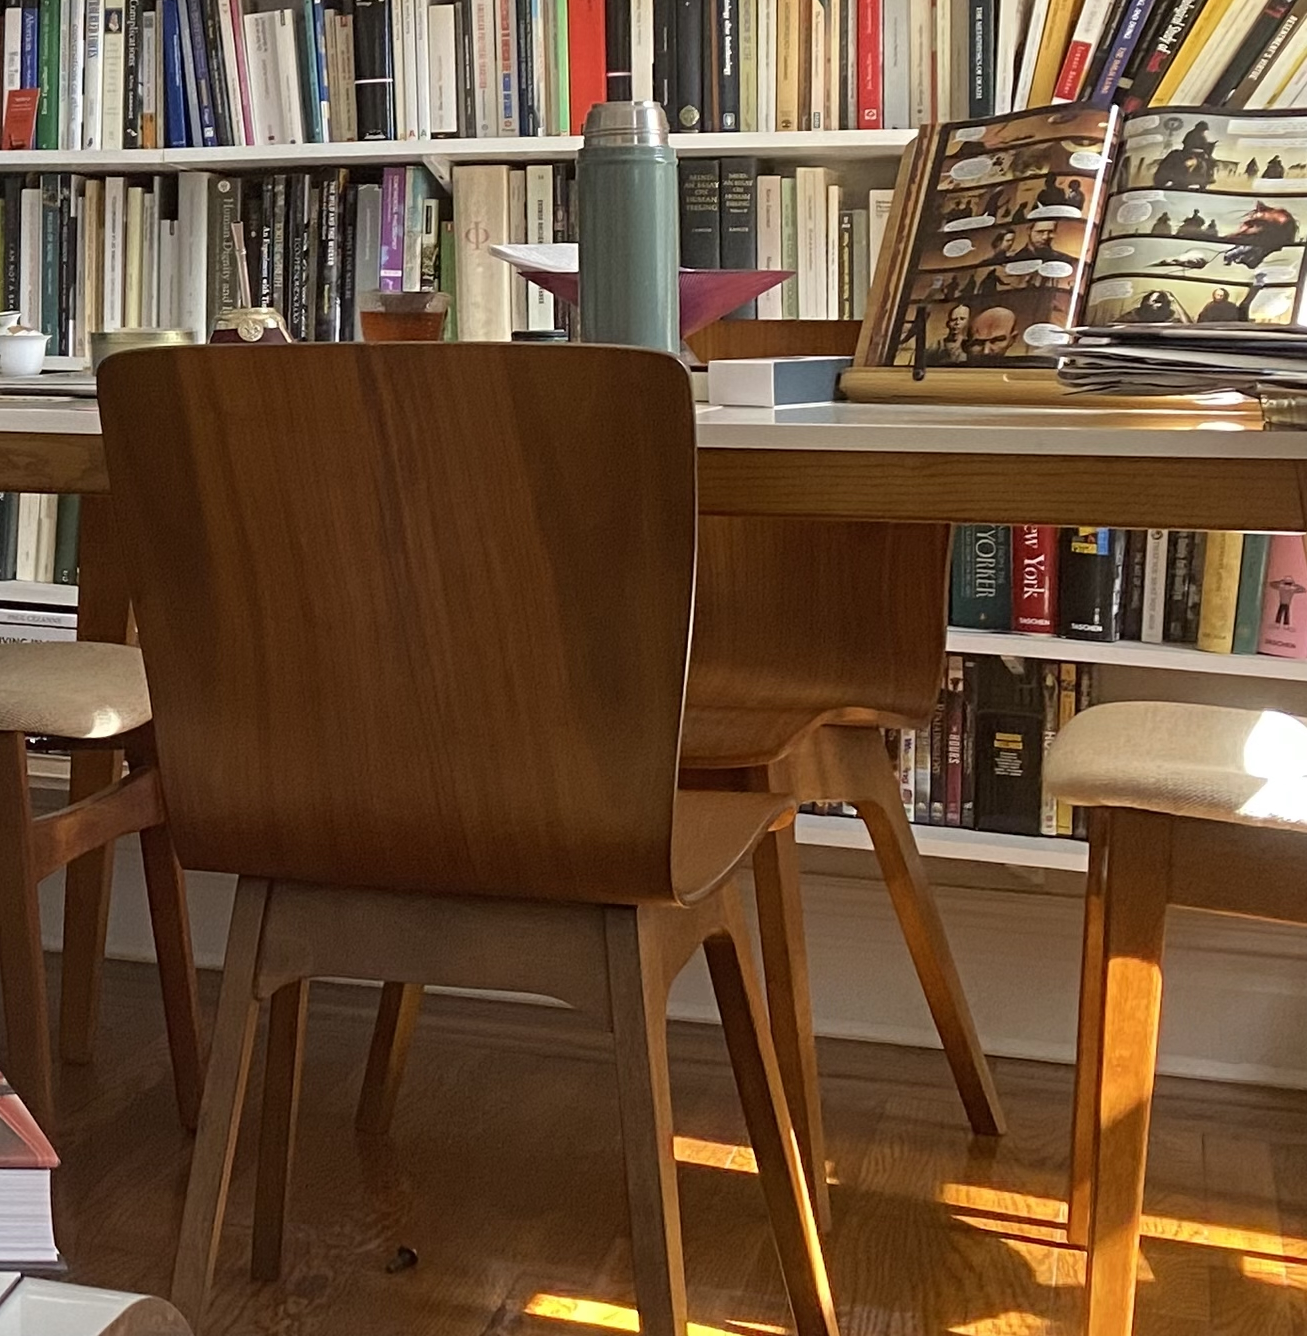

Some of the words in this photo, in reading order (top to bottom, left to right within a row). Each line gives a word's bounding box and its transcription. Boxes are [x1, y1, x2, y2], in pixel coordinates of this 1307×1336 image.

[25, 12, 34, 51] Abortion
[1159, 24, 1183, 45] Study
[1263, 15, 1297, 59] RESENTMENT'S
[1156, 44, 1171, 55] of
[975, 66, 982, 75] OF
[1248, 59, 1269, 80] VIRTUE
[223, 198, 233, 238] Human
[262, 226, 270, 237] An
[221, 240, 233, 281] Dignity
[261, 239, 270, 277] Experiment
[8, 285, 15, 293] A
[222, 284, 232, 303] and
[262, 279, 270, 294] with
[1024, 525, 1038, 548] ew
[976, 530, 996, 598] YORKER
[1023, 554, 1045, 599] York
[948, 734, 960, 764] HOURS
